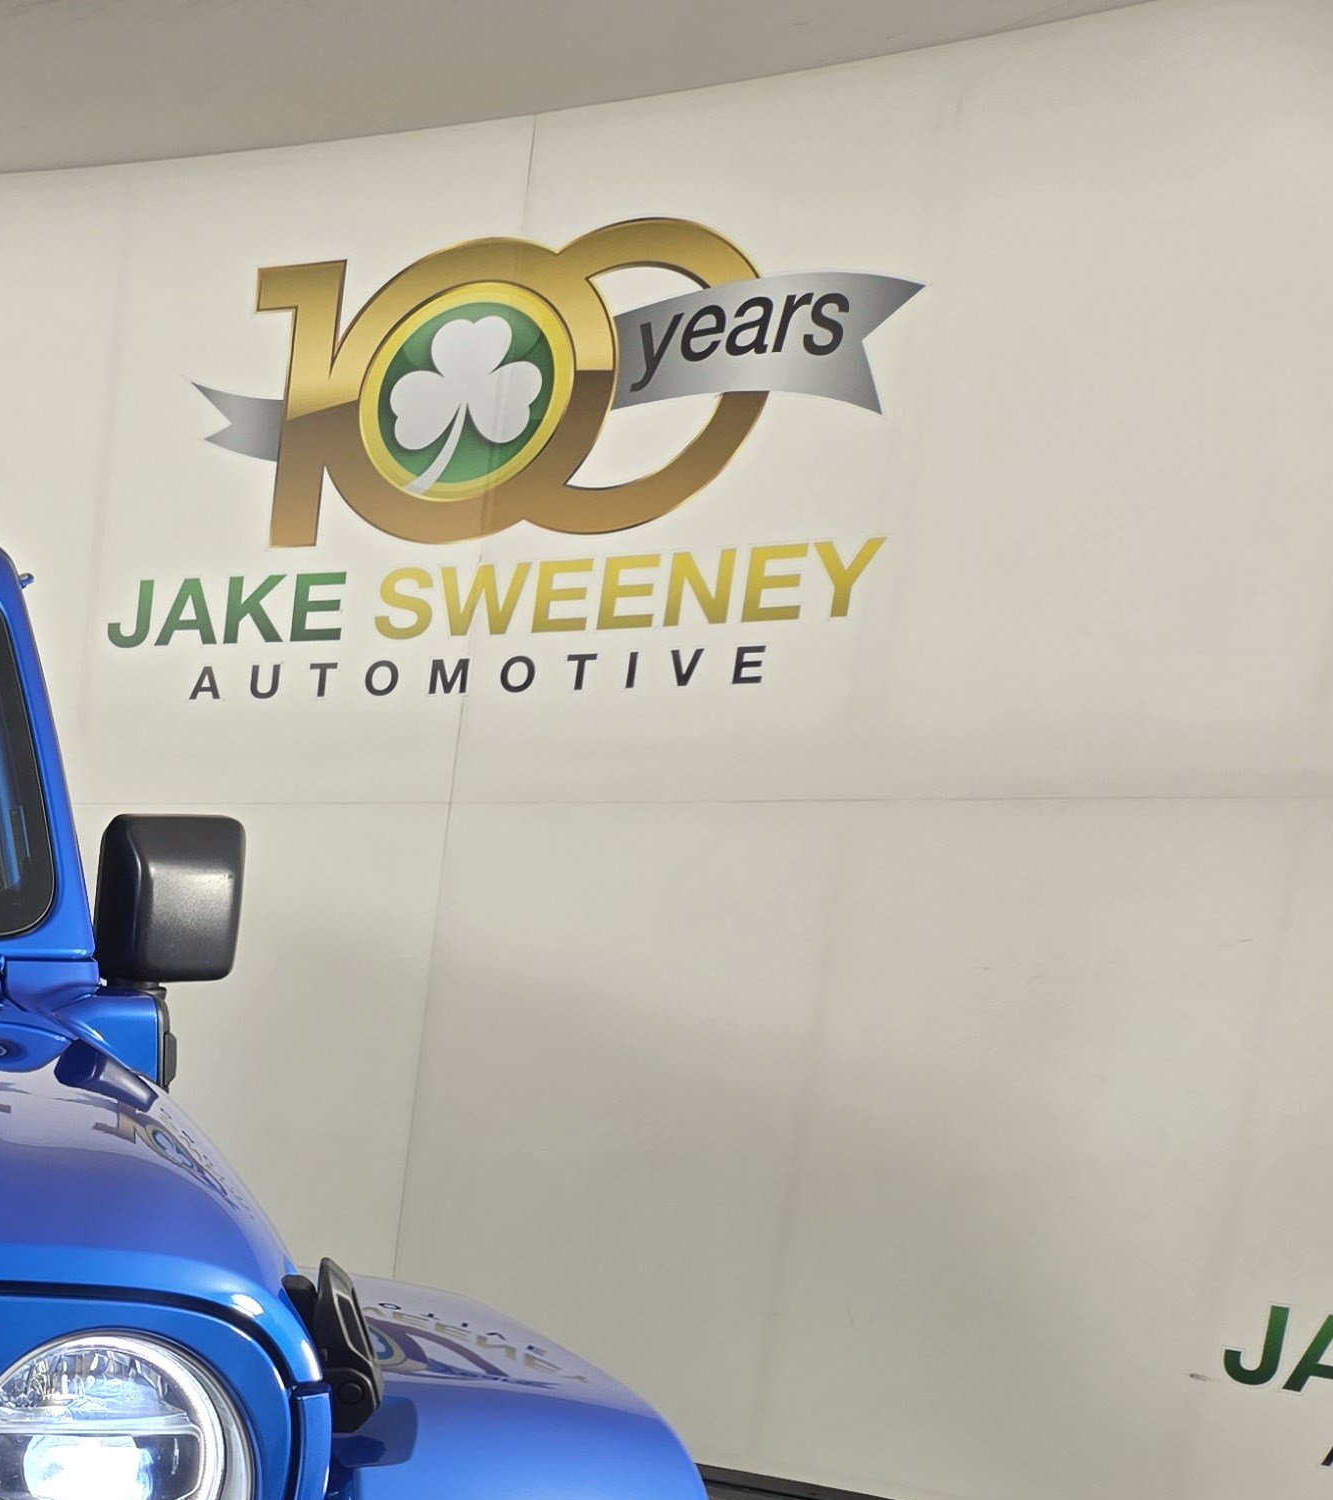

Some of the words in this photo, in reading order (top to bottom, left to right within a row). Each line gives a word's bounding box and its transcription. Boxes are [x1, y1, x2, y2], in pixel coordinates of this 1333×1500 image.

[256, 216, 771, 548] 100
[629, 291, 850, 392] years
[107, 571, 347, 648] JAKE
[374, 537, 886, 641] SWEENEY
[189, 645, 767, 701] AUTOMOTIVE
